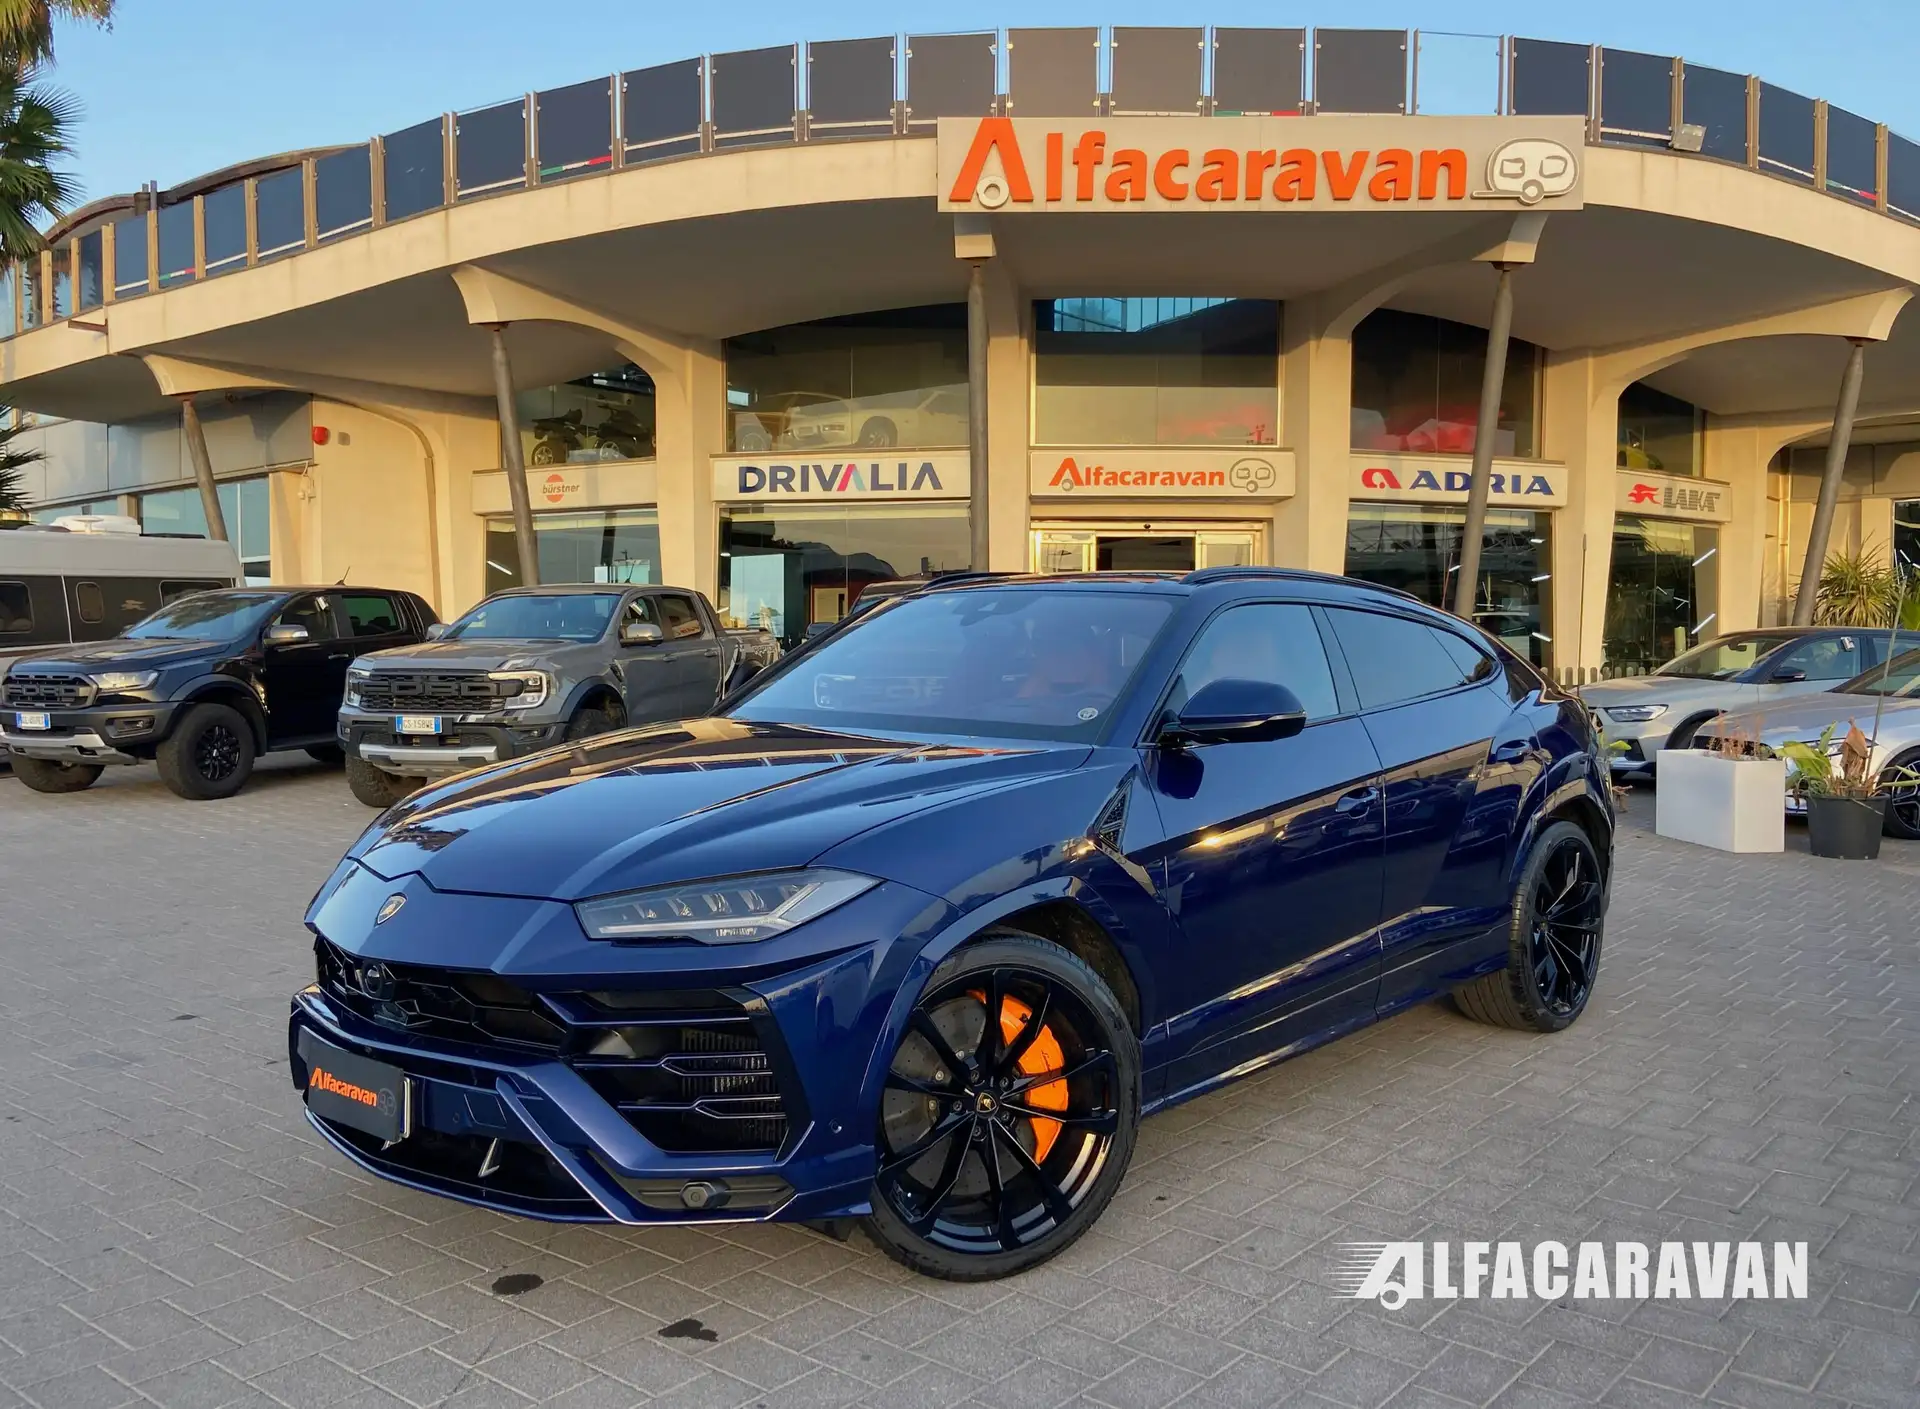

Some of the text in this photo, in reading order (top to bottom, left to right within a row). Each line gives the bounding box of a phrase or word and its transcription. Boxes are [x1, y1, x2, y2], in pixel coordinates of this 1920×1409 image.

[948, 117, 1468, 204] Alfacaravan
[738, 462, 944, 494] DRIVALIA
[1048, 457, 1225, 487] Alfacaravan
[1408, 469, 1556, 497] ADRIA
[542, 483, 580, 494] bürstner
[310, 1066, 378, 1108] Alfacaravan
